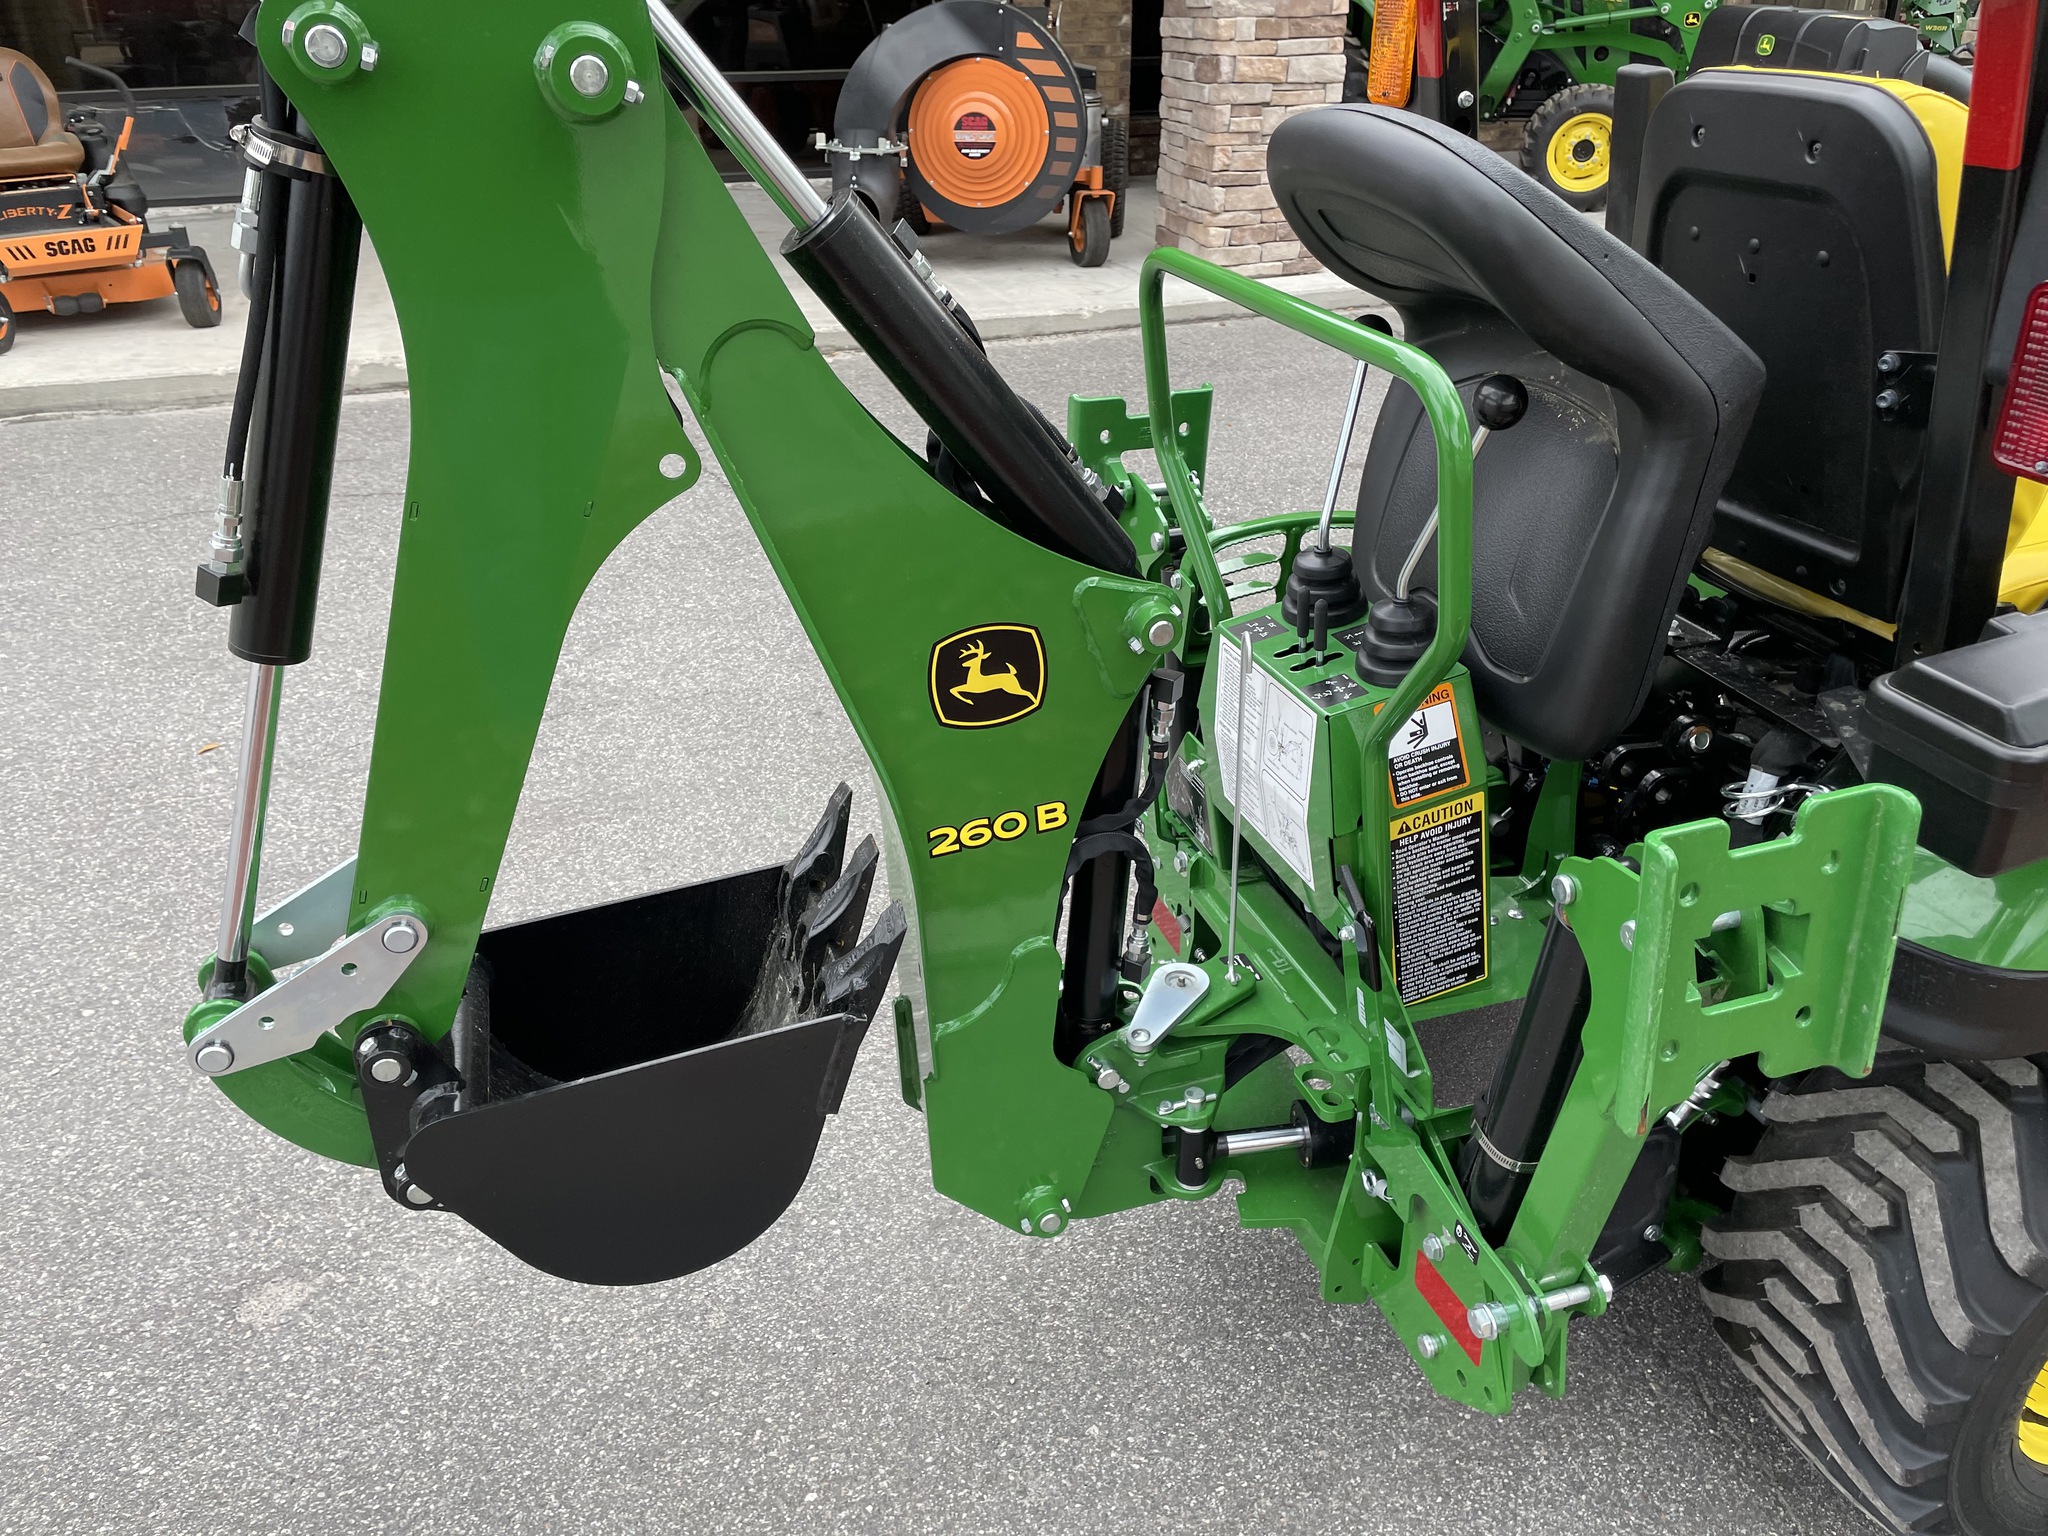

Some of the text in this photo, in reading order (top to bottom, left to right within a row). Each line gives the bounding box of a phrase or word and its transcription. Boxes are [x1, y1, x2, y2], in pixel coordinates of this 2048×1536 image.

[44, 238, 95, 257] SCAG
[1392, 740, 1451, 763] AVOID CRUSH INJURY
[1403, 756, 1422, 766] DEATH
[1412, 798, 1473, 830] CAUTION
[927, 800, 1070, 858] 260 B
[1399, 815, 1472, 846] HELP AVOID INJURY
